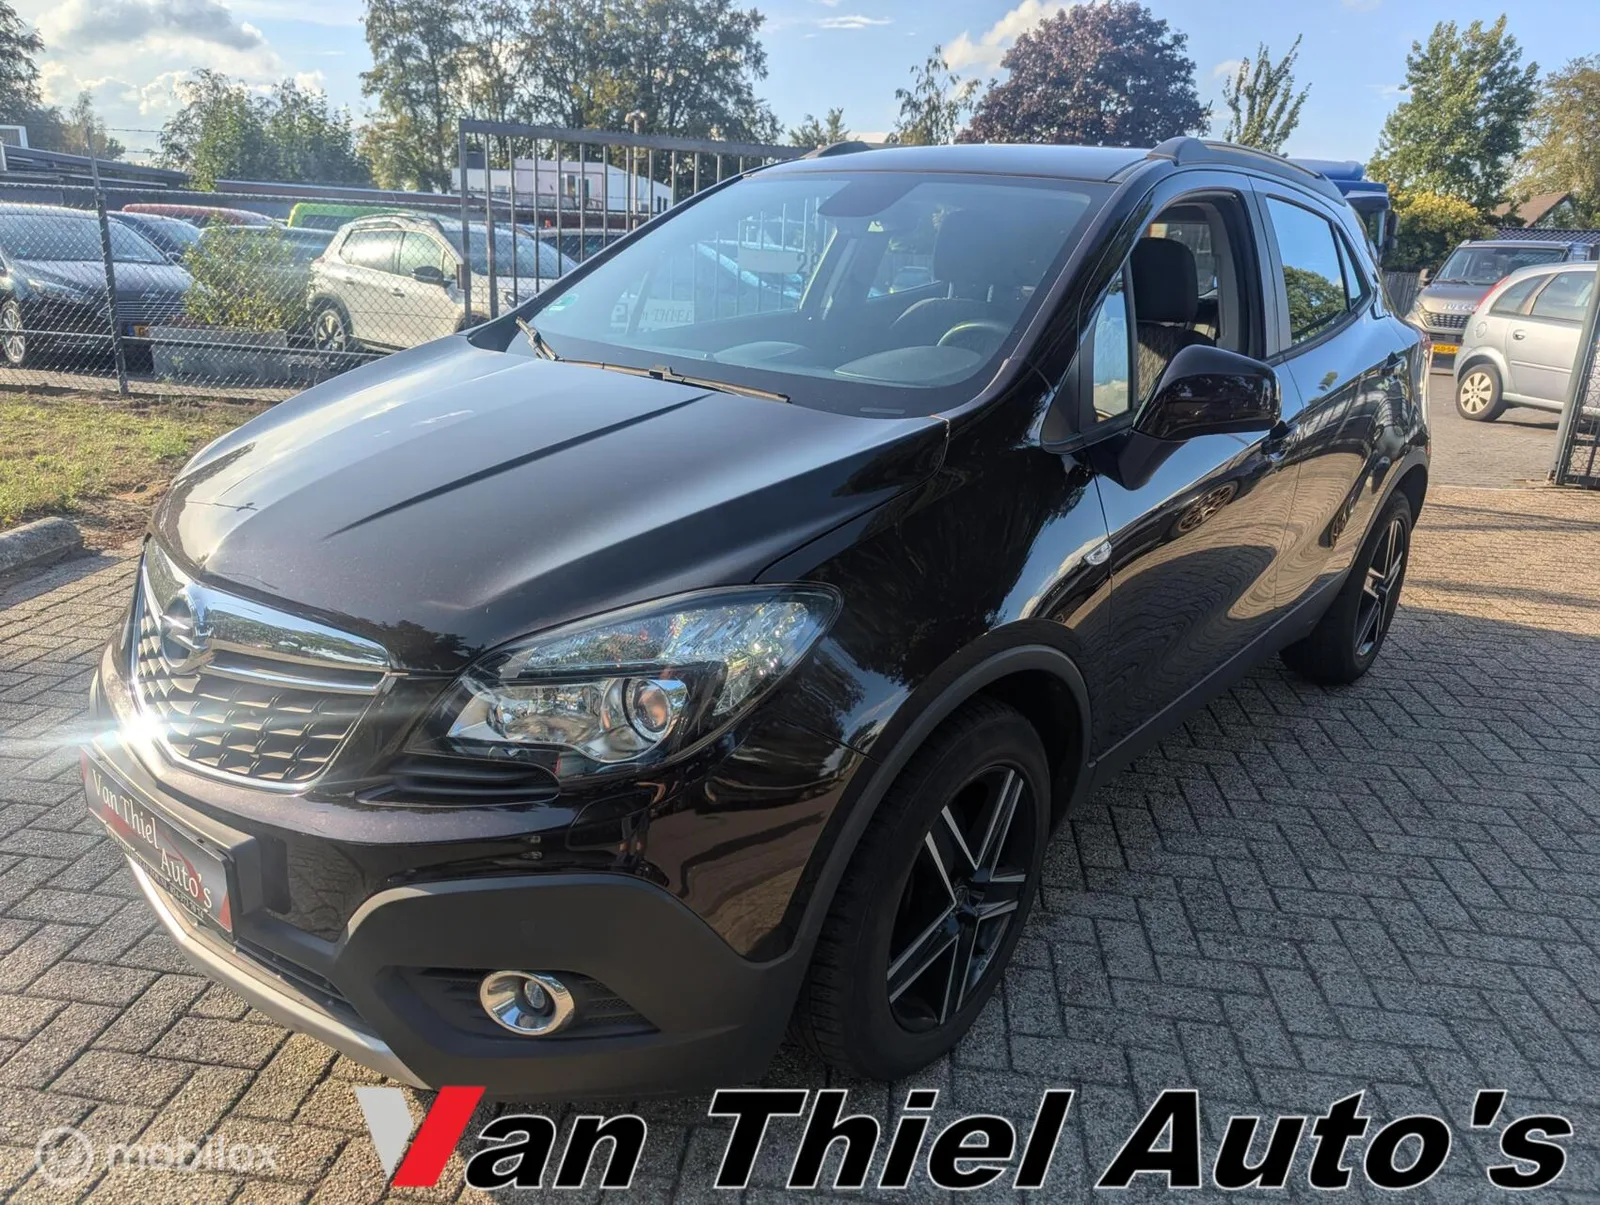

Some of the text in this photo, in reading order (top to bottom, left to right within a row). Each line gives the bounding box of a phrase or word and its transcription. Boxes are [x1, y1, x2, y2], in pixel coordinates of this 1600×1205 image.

[92, 769, 119, 815] Van
[120, 795, 159, 849] Thiel
[160, 848, 212, 909] Auto's
